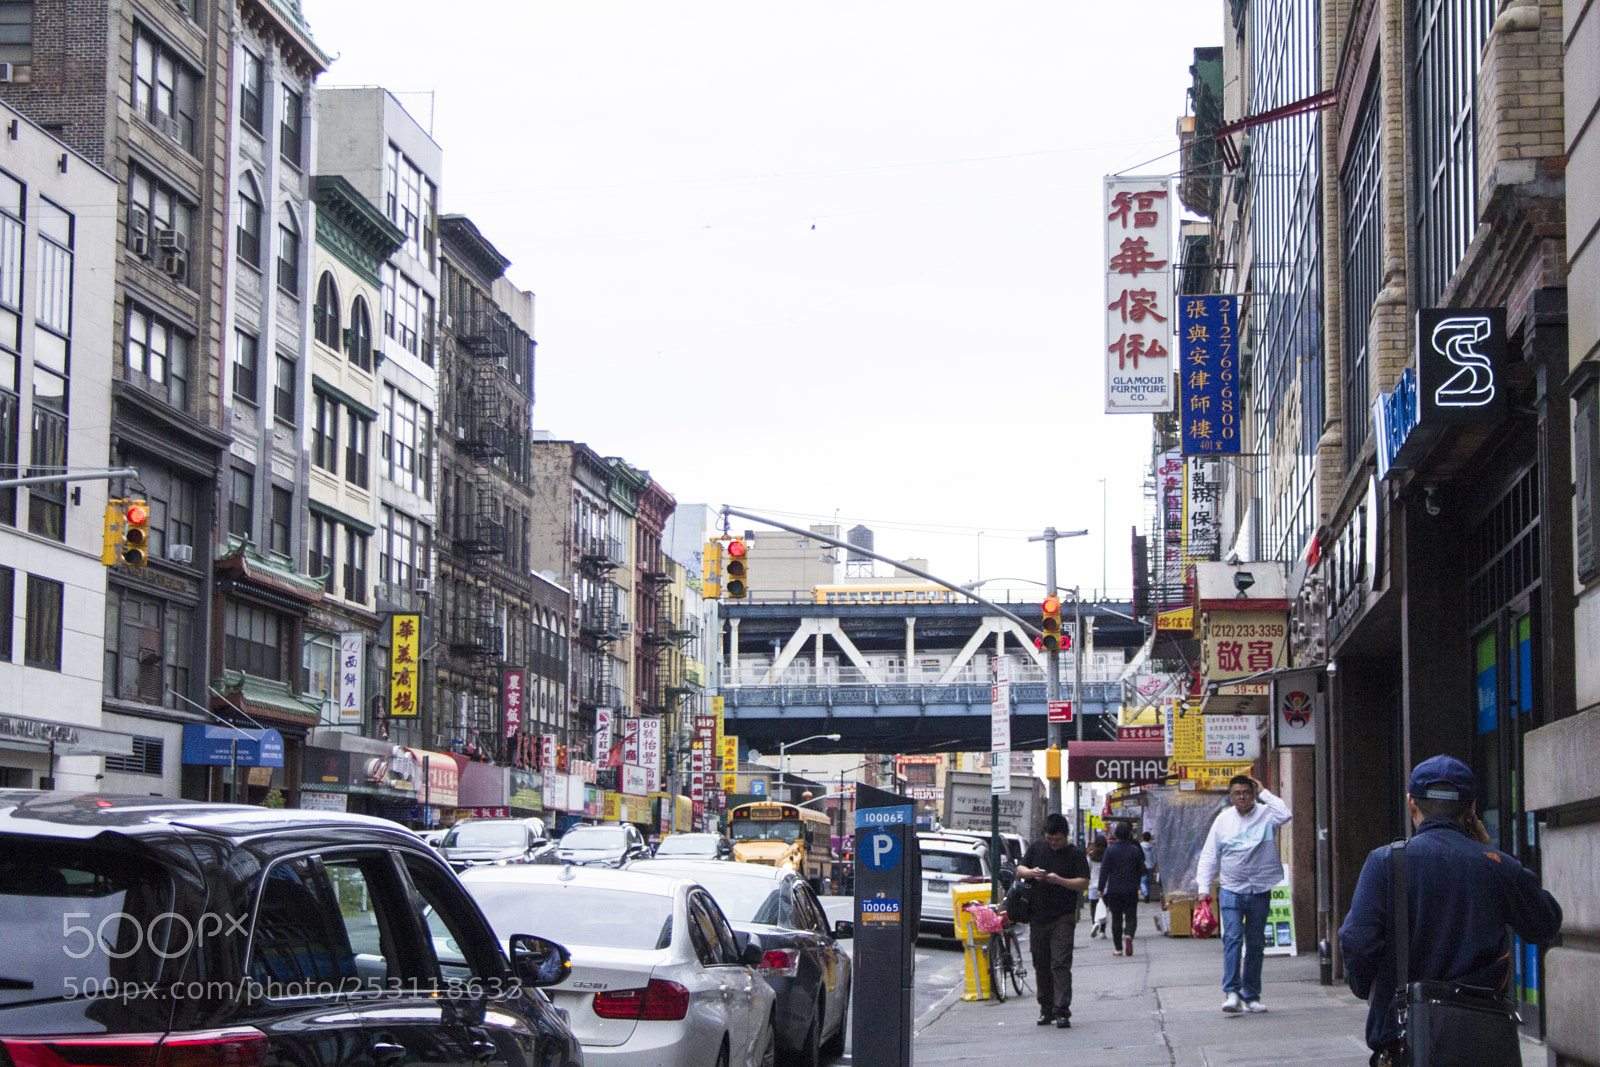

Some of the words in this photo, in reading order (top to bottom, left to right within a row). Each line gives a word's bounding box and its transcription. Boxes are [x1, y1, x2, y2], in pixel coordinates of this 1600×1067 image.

[1107, 190, 1168, 370] 福華傢俬
[1186, 299, 1214, 440] 張與安律師樓
[1113, 376, 1164, 385] GLAMOUR
[1110, 385, 1167, 393] FURNITURE
[1130, 393, 1148, 401] CO.
[1211, 624, 1235, 638] (212)
[1236, 624, 1284, 638] 233-3359
[394, 618, 416, 713] 華美商場
[344, 655, 358, 708] 西餅屋
[1234, 685, 1264, 695] 39-41
[1225, 742, 1246, 757] 43
[1096, 760, 1169, 779] CATHAY
[754, 784, 762, 793] P
[972, 805, 1008, 815] MARET
[865, 812, 904, 823] 100065
[873, 834, 893, 866] P
[863, 903, 899, 912] 100065
